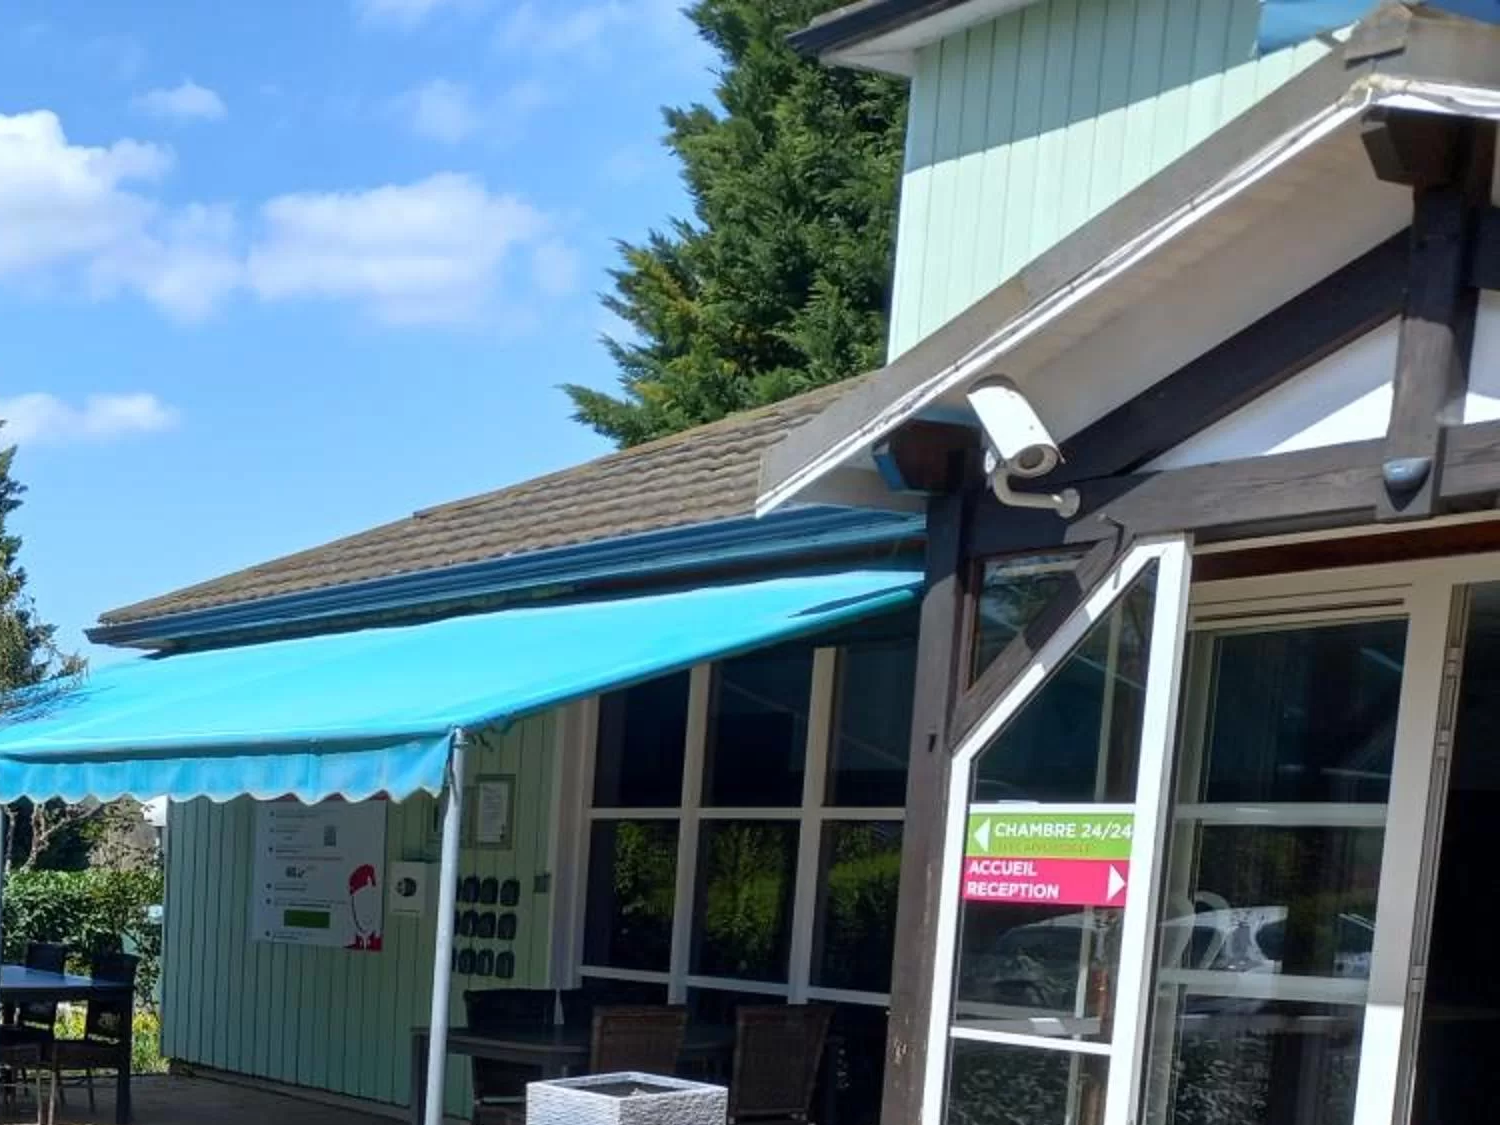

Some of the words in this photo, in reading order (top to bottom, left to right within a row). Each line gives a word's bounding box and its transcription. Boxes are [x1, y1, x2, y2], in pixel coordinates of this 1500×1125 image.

[994, 822, 1077, 838] CHAMBRE
[1080, 822, 1134, 841] 24/24
[968, 860, 1038, 876] ACCUEIL
[966, 882, 1060, 899] RECEPTION
